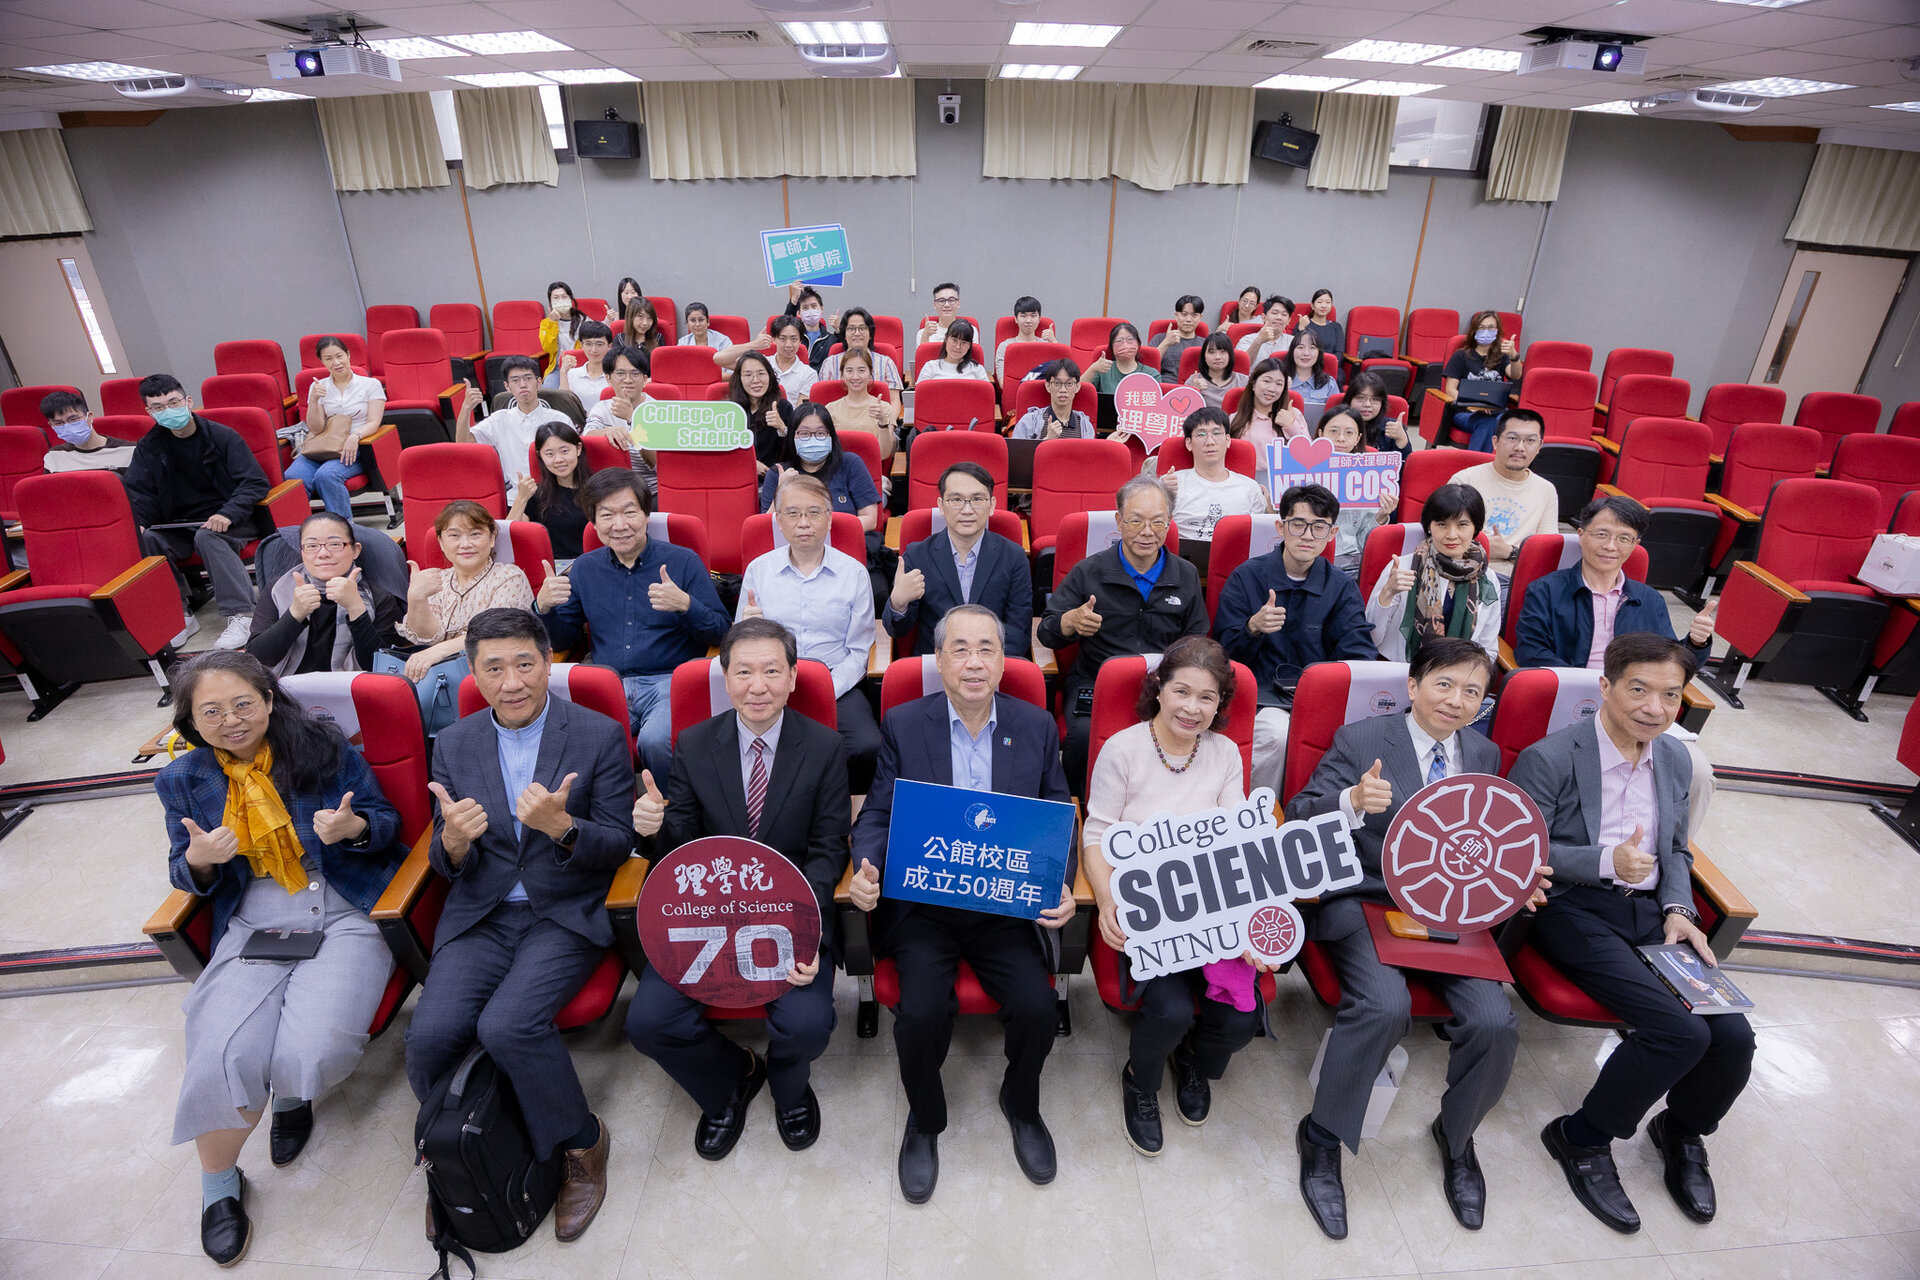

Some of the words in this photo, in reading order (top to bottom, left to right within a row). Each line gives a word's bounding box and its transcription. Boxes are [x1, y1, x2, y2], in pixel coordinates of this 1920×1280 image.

[793, 249, 843, 275] 理學院
[1125, 391, 1157, 407] 我愛
[643, 404, 714, 425] College
[714, 411, 735, 430] of
[678, 427, 752, 447] Science
[1274, 440, 1282, 470] I
[1346, 469, 1398, 500] COS
[1108, 812, 1229, 861] College
[1237, 795, 1269, 829] of
[922, 836, 1032, 874] 公館校區
[674, 856, 774, 896] 理學院
[902, 865, 1043, 907] 成立50週年
[1118, 819, 1356, 932] SCIENCE
[661, 902, 717, 919] College
[720, 900, 735, 914] of
[738, 900, 794, 914] Science
[667, 924, 796, 985] 70
[1133, 920, 1240, 973] NTNU
